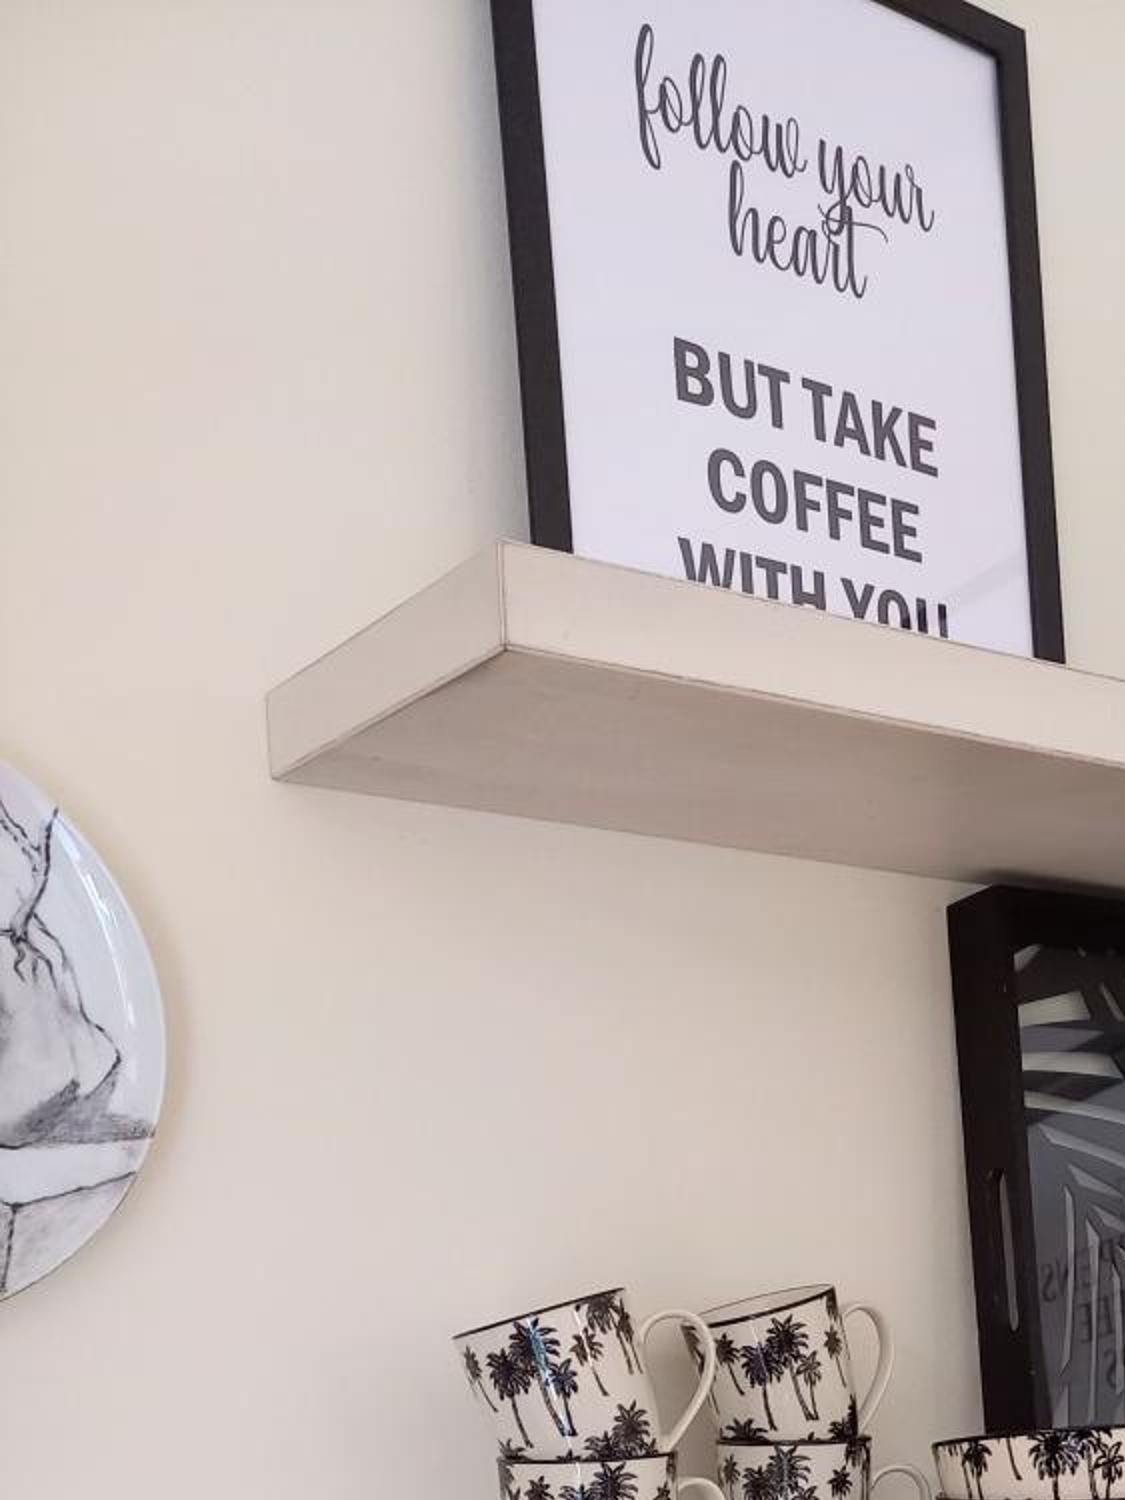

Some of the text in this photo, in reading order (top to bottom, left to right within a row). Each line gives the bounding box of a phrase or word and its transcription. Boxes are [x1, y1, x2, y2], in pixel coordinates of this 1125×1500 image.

[635, 23, 935, 236] follow your
[728, 160, 888, 299] heart
[673, 336, 939, 478] BUT TAKE
[677, 536, 827, 611] WITH
[707, 447, 923, 564] COFFEE
